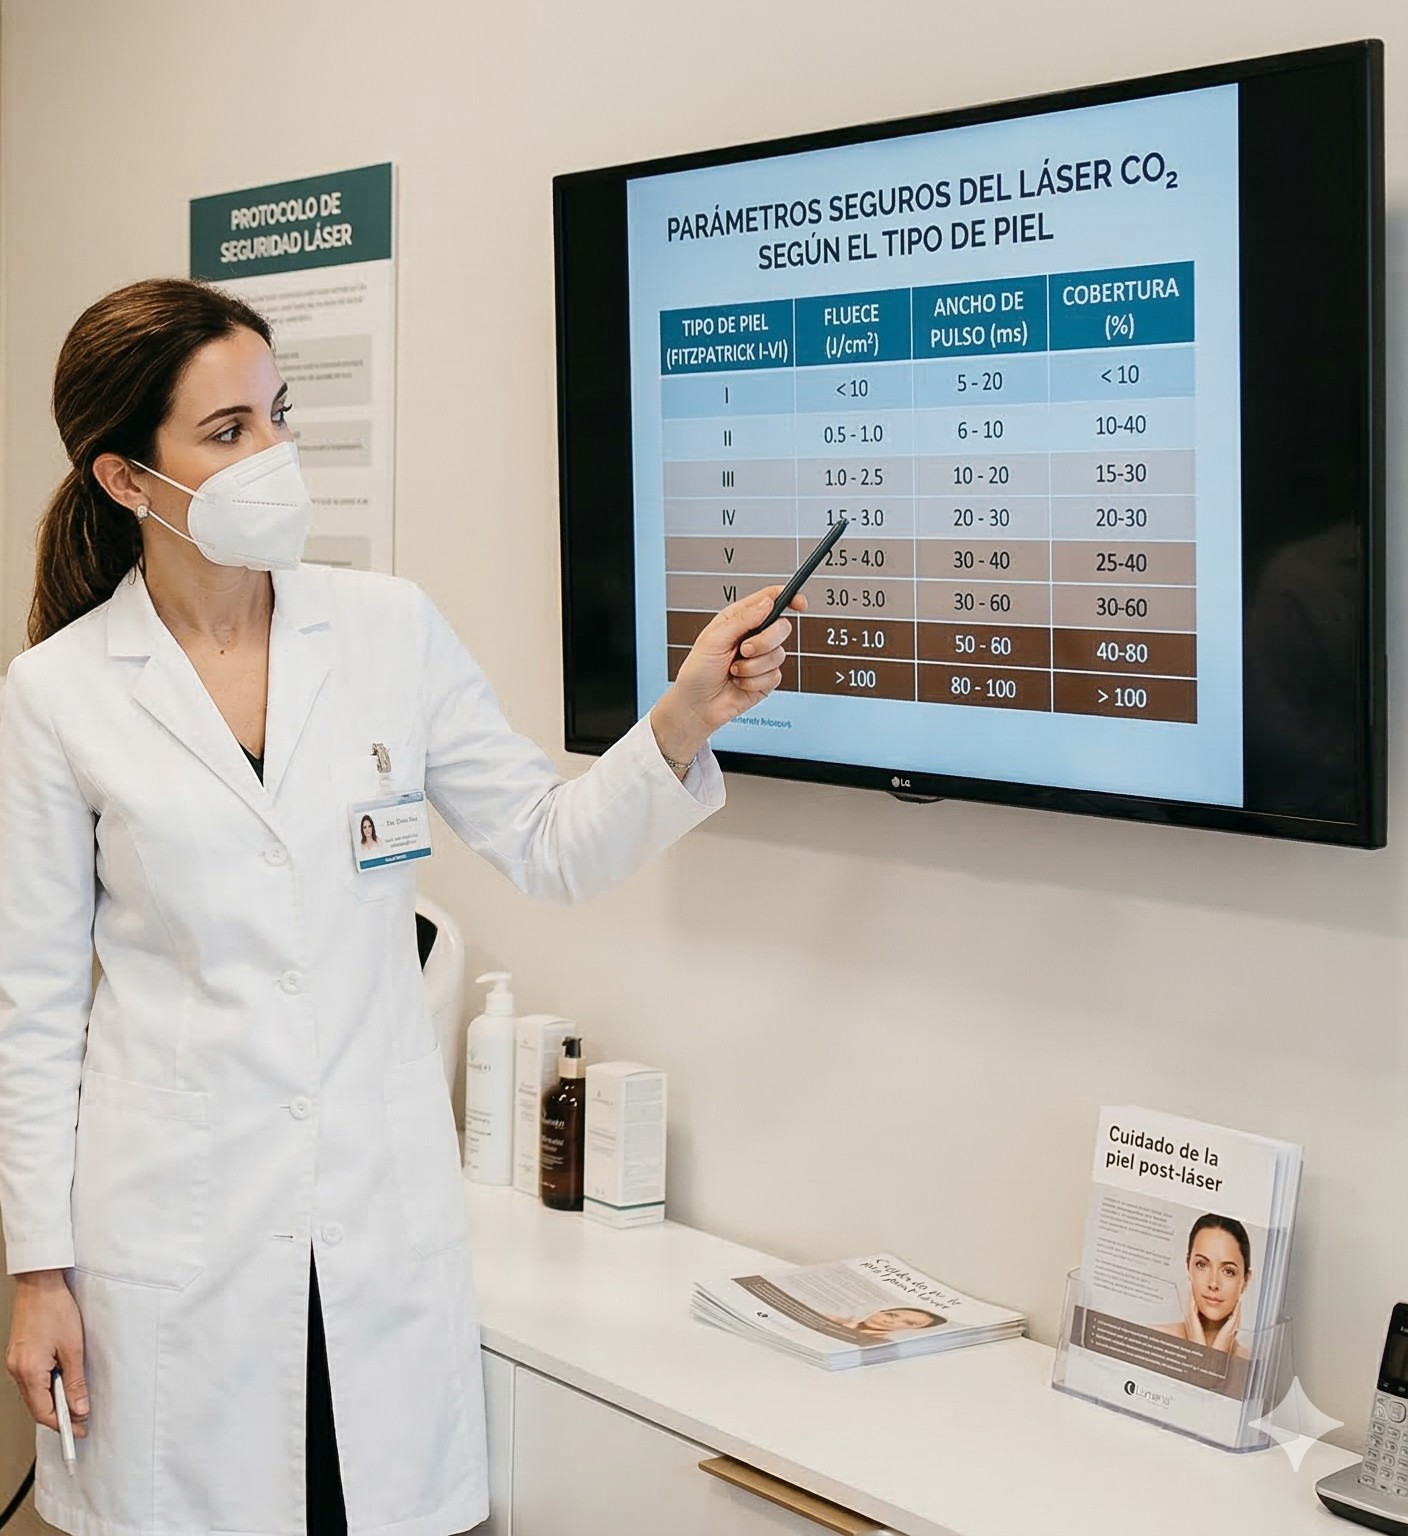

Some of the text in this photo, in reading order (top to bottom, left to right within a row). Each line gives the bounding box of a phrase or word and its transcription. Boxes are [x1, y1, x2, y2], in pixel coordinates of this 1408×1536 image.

[667, 197, 823, 243] PARÁMETROS
[829, 181, 952, 223] SEGUROS
[959, 172, 1013, 207] DEL
[1019, 157, 1113, 199] LÁSER
[230, 191, 342, 231] PROTOCOLO DE
[219, 222, 353, 264] SEGURIDAD LÁSER
[758, 212, 1055, 270] SEGÚN EL TIPO DE PIEL
[1062, 277, 1180, 306] COBERTURA
[933, 291, 1024, 317] ANCHO DE
[682, 313, 769, 337] TIPO DE PIEL
[824, 304, 880, 326] FLUECE
[930, 321, 1028, 348] PULSO (ms)
[1105, 313, 1135, 341] (%)
[666, 338, 788, 370] (FITZPATRICK I-VI)
[957, 374, 967, 392] 5
[981, 372, 1003, 391] 20
[1100, 365, 1140, 385] < 10
[724, 387, 729, 404] I
[836, 379, 869, 398] < 10
[824, 426, 847, 444] 0.5
[860, 425, 883, 443] 1.0
[957, 422, 968, 440] 6
[983, 420, 1004, 439] 10
[1095, 415, 1147, 436] 10-40
[723, 430, 732, 447] II
[722, 470, 735, 488] III
[825, 469, 848, 487] 1.0
[860, 468, 884, 486] 2.5
[953, 466, 973, 485] 10
[988, 466, 1010, 485] 20
[1095, 463, 1147, 483] 15-30
[722, 508, 736, 527] IV
[860, 509, 884, 527] 3.0
[953, 508, 974, 527] 20
[989, 508, 1010, 527] 30
[1095, 508, 1148, 528] 20-30
[723, 547, 735, 565] V
[825, 549, 848, 567] 2.5
[861, 550, 885, 567] 4.0
[953, 551, 975, 569] 30
[989, 551, 1011, 570] 40
[1095, 553, 1148, 573] 25-40
[722, 585, 737, 603] VI
[826, 589, 849, 607] 3.0
[953, 593, 975, 612] 30
[989, 594, 1011, 613] 60
[1096, 597, 1148, 618] 30-60
[826, 628, 849, 646] 2.5
[861, 630, 885, 648] 1.0
[955, 634, 976, 654] 50
[990, 636, 1012, 656] 60
[1096, 642, 1149, 664] 40-80
[835, 669, 877, 689] > 100
[950, 676, 971, 695] 80
[985, 679, 1017, 699] 100
[1097, 687, 1148, 709] > 100
[1109, 1125, 1219, 1167] Cuidado de la
[1105, 1149, 1223, 1193] piel post-láser
